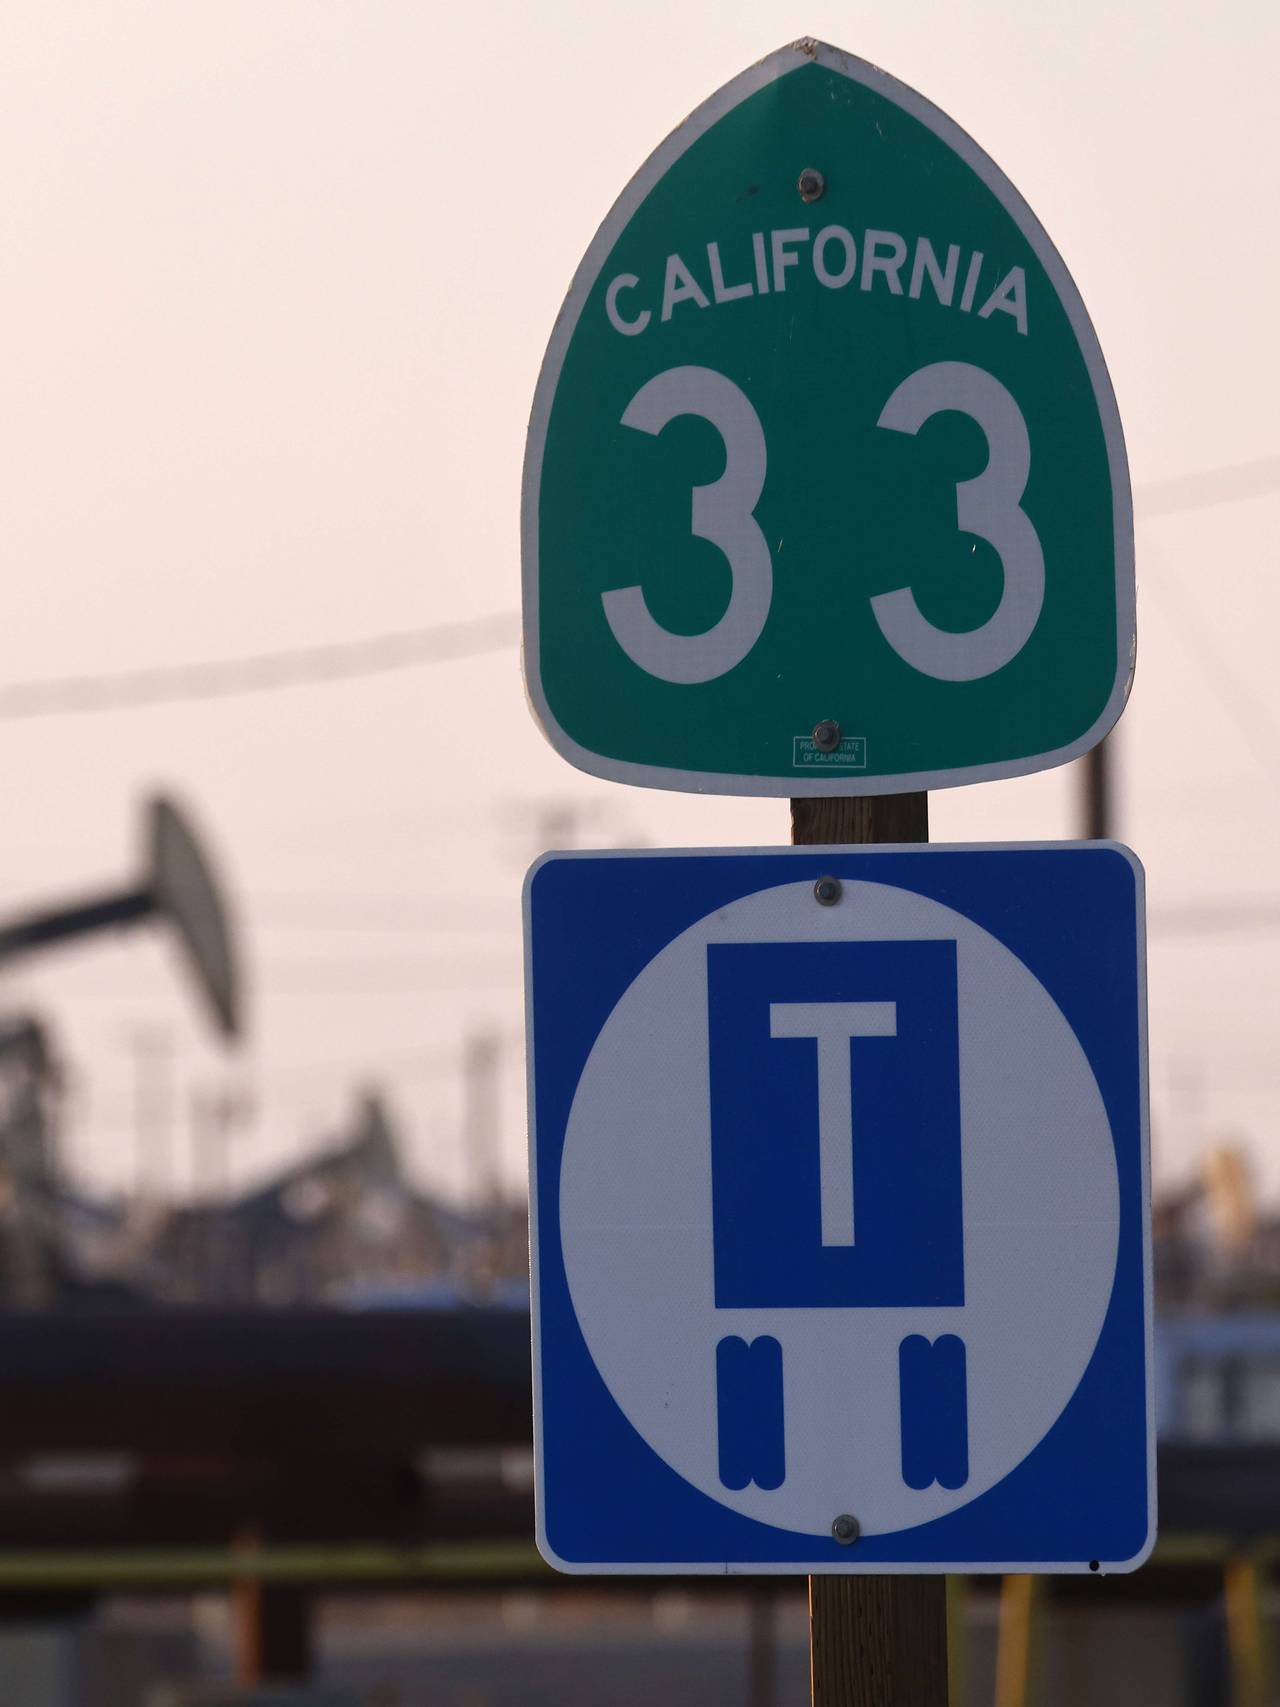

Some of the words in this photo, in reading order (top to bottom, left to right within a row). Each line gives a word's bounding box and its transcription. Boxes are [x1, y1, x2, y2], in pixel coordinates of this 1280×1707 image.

[606, 224, 1028, 336] CALIFORNIA
[601, 361, 1046, 684] 33
[803, 753, 814, 762] OF
[814, 753, 856, 762] CALIFORNIA
[840, 742, 860, 751] STATE
[770, 1001, 897, 1247] T
